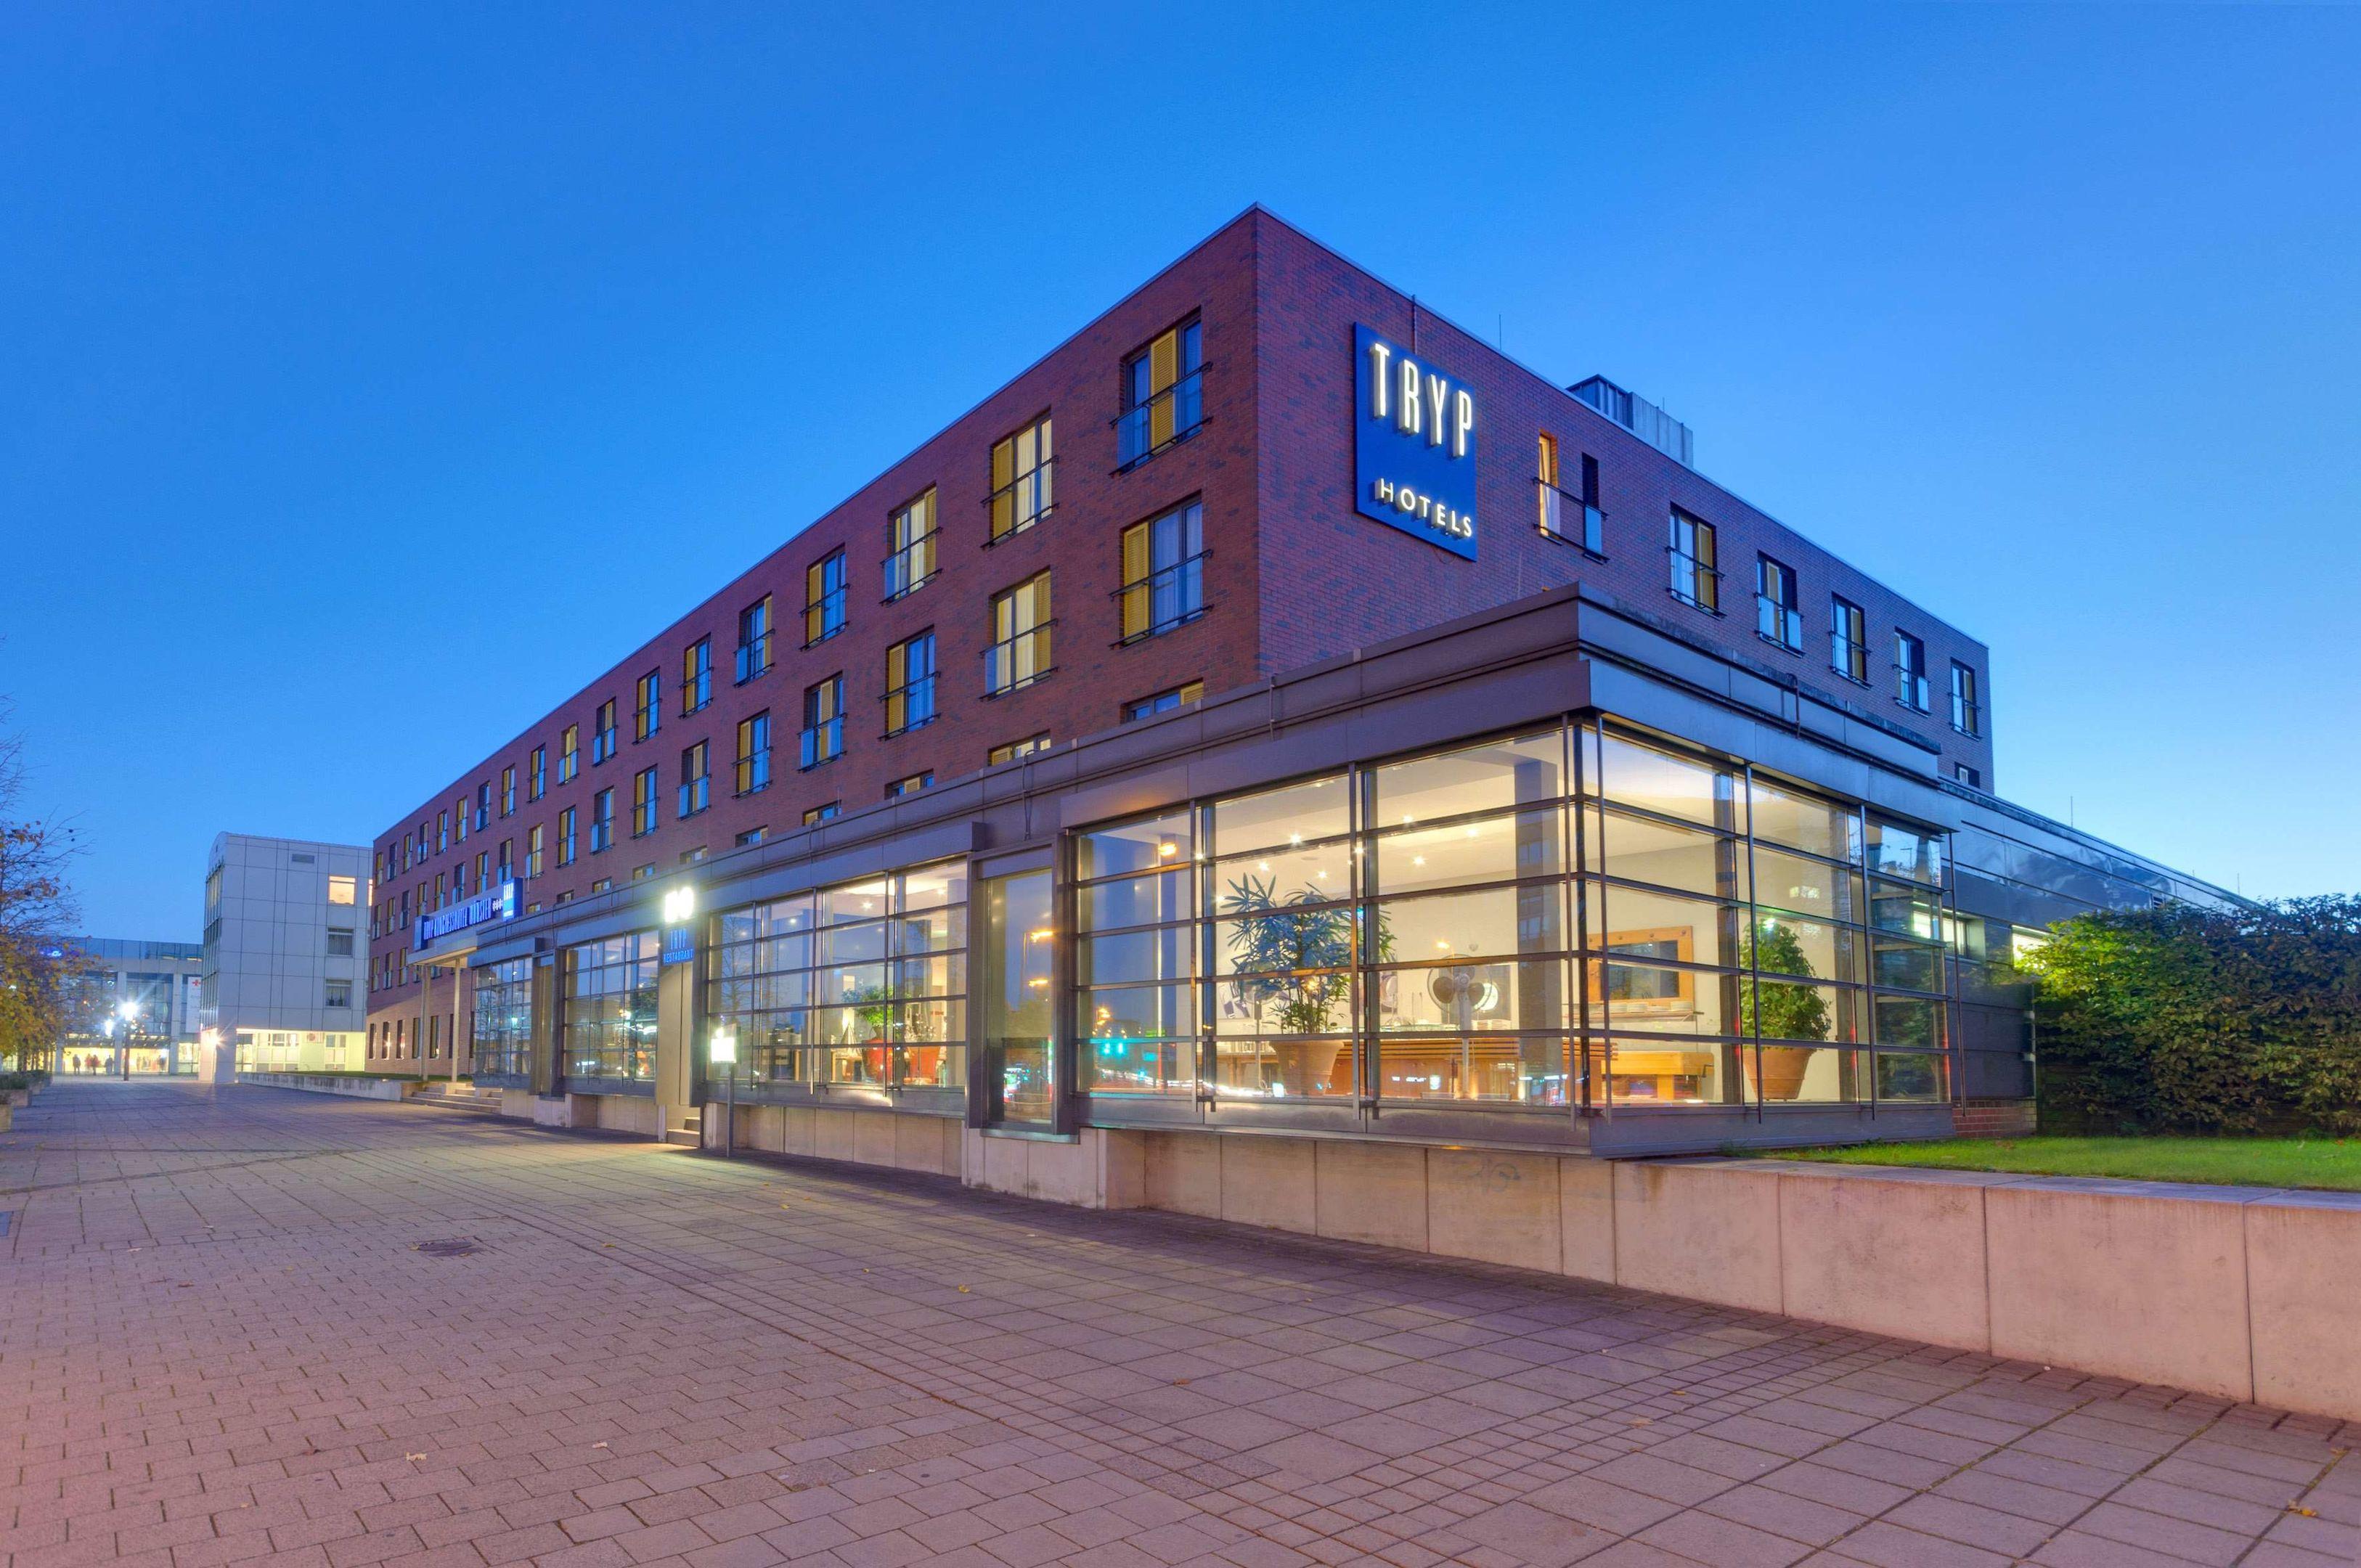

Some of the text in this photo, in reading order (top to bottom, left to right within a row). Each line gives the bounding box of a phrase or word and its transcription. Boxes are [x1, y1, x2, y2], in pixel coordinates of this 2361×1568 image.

[1370, 343, 1472, 458] TRYP
[1374, 478, 1472, 538] HOTELS
[663, 949, 693, 963] RESTAURANT
[669, 928, 687, 950] TRYP
